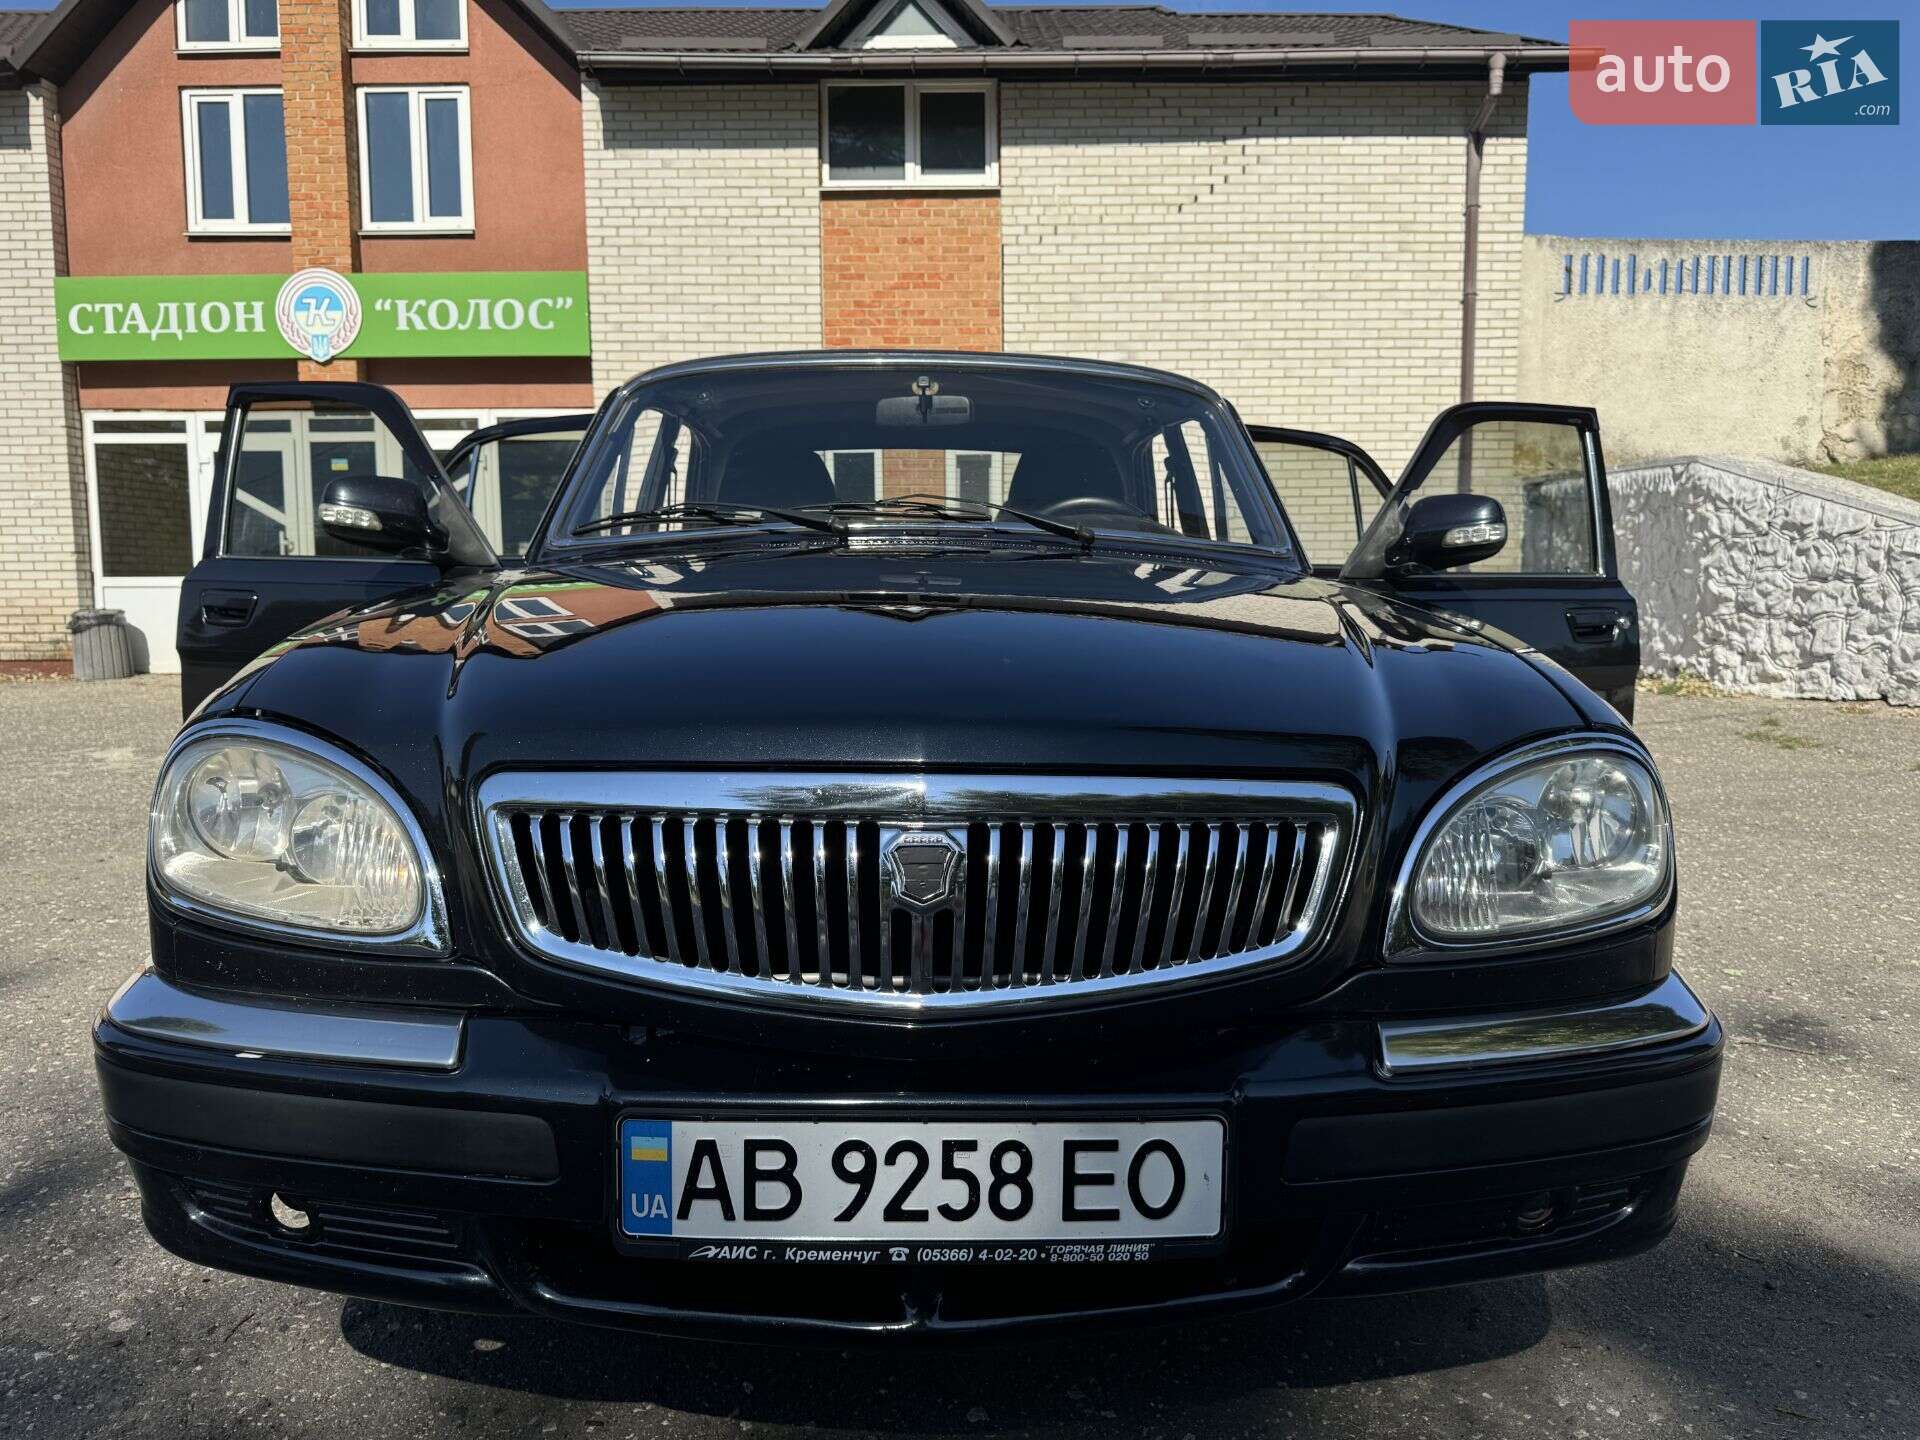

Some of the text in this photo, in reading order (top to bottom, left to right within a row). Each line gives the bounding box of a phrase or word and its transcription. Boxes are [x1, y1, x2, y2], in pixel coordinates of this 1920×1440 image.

[67, 301, 266, 341] СТАДІОН
[676, 1138, 1186, 1222] AB 9258 EO
[631, 1193, 669, 1219] UA
[718, 1246, 757, 1260] АИС
[784, 1247, 881, 1264] Кременчуг
[917, 1248, 974, 1262] (05366)
[978, 1248, 1038, 1261] 4-02-20
[1108, 1252, 1131, 1262] 020
[1134, 1252, 1150, 1261] 50
